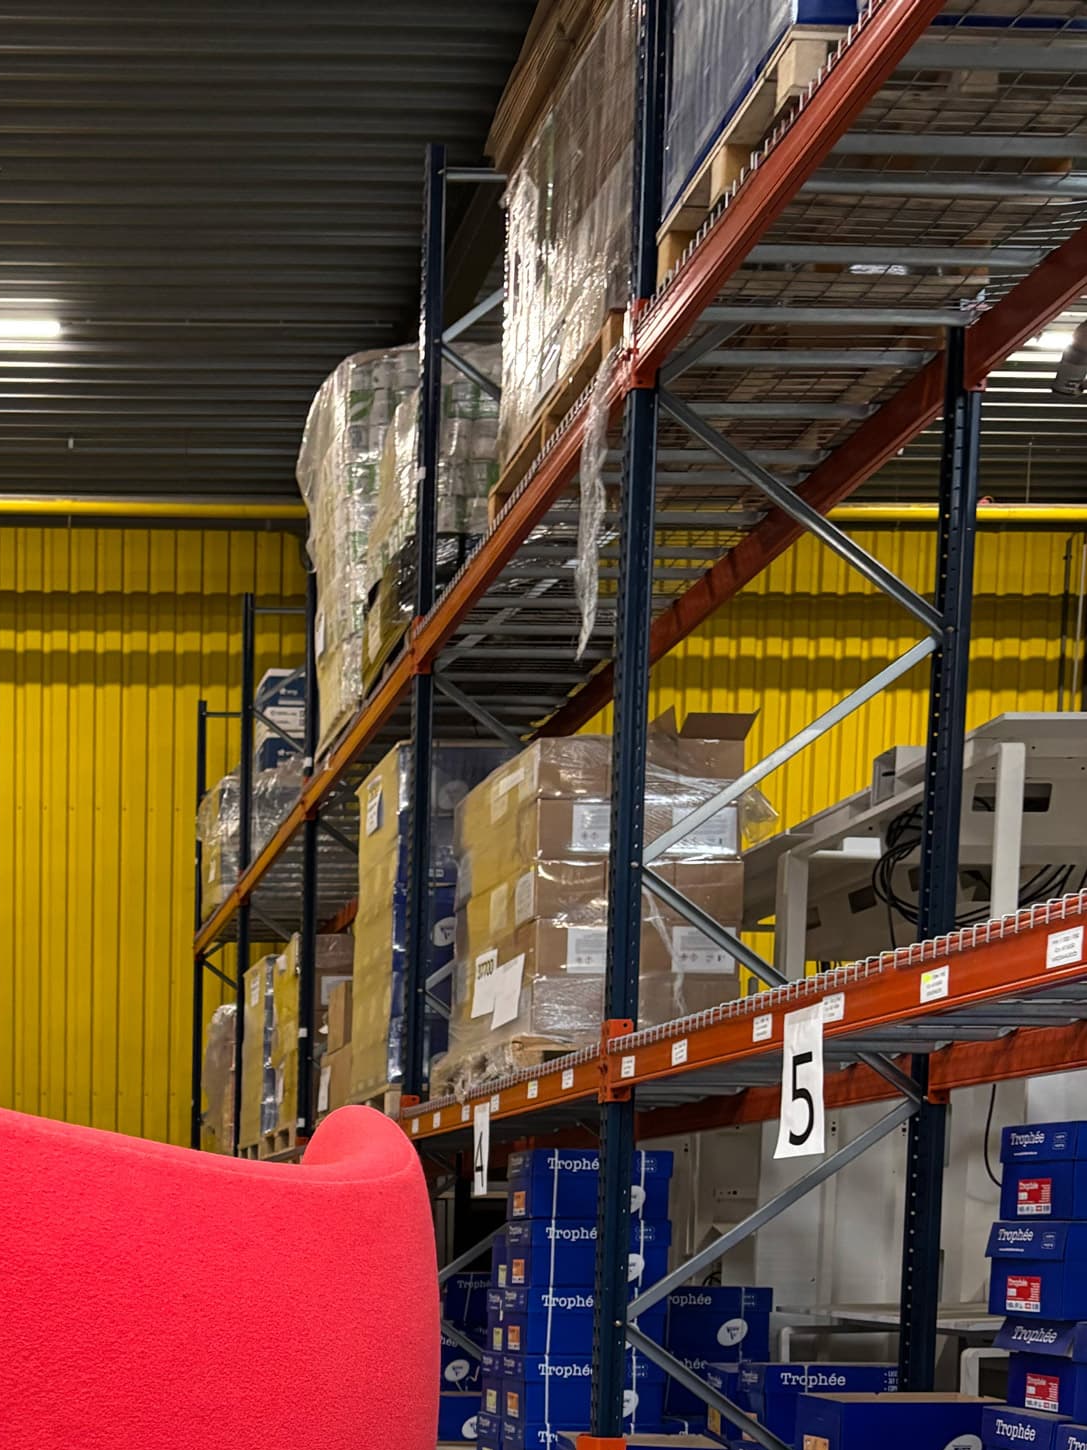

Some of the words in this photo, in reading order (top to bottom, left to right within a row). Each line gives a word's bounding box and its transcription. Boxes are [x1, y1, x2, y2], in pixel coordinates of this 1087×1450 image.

[788, 1050, 815, 1146] 5
[1010, 1130, 1045, 1148] Trophée
[547, 1157, 600, 1173] Trophé
[545, 1226, 598, 1242] Trophé
[997, 1227, 1034, 1244] Trophée
[457, 1279, 491, 1290] Trophé
[541, 1294, 594, 1310] Trophé
[668, 1293, 712, 1307] rophée
[1011, 1325, 1058, 1344] Trophée
[780, 1372, 846, 1389] Trophée
[995, 1418, 1036, 1441] Trophée
